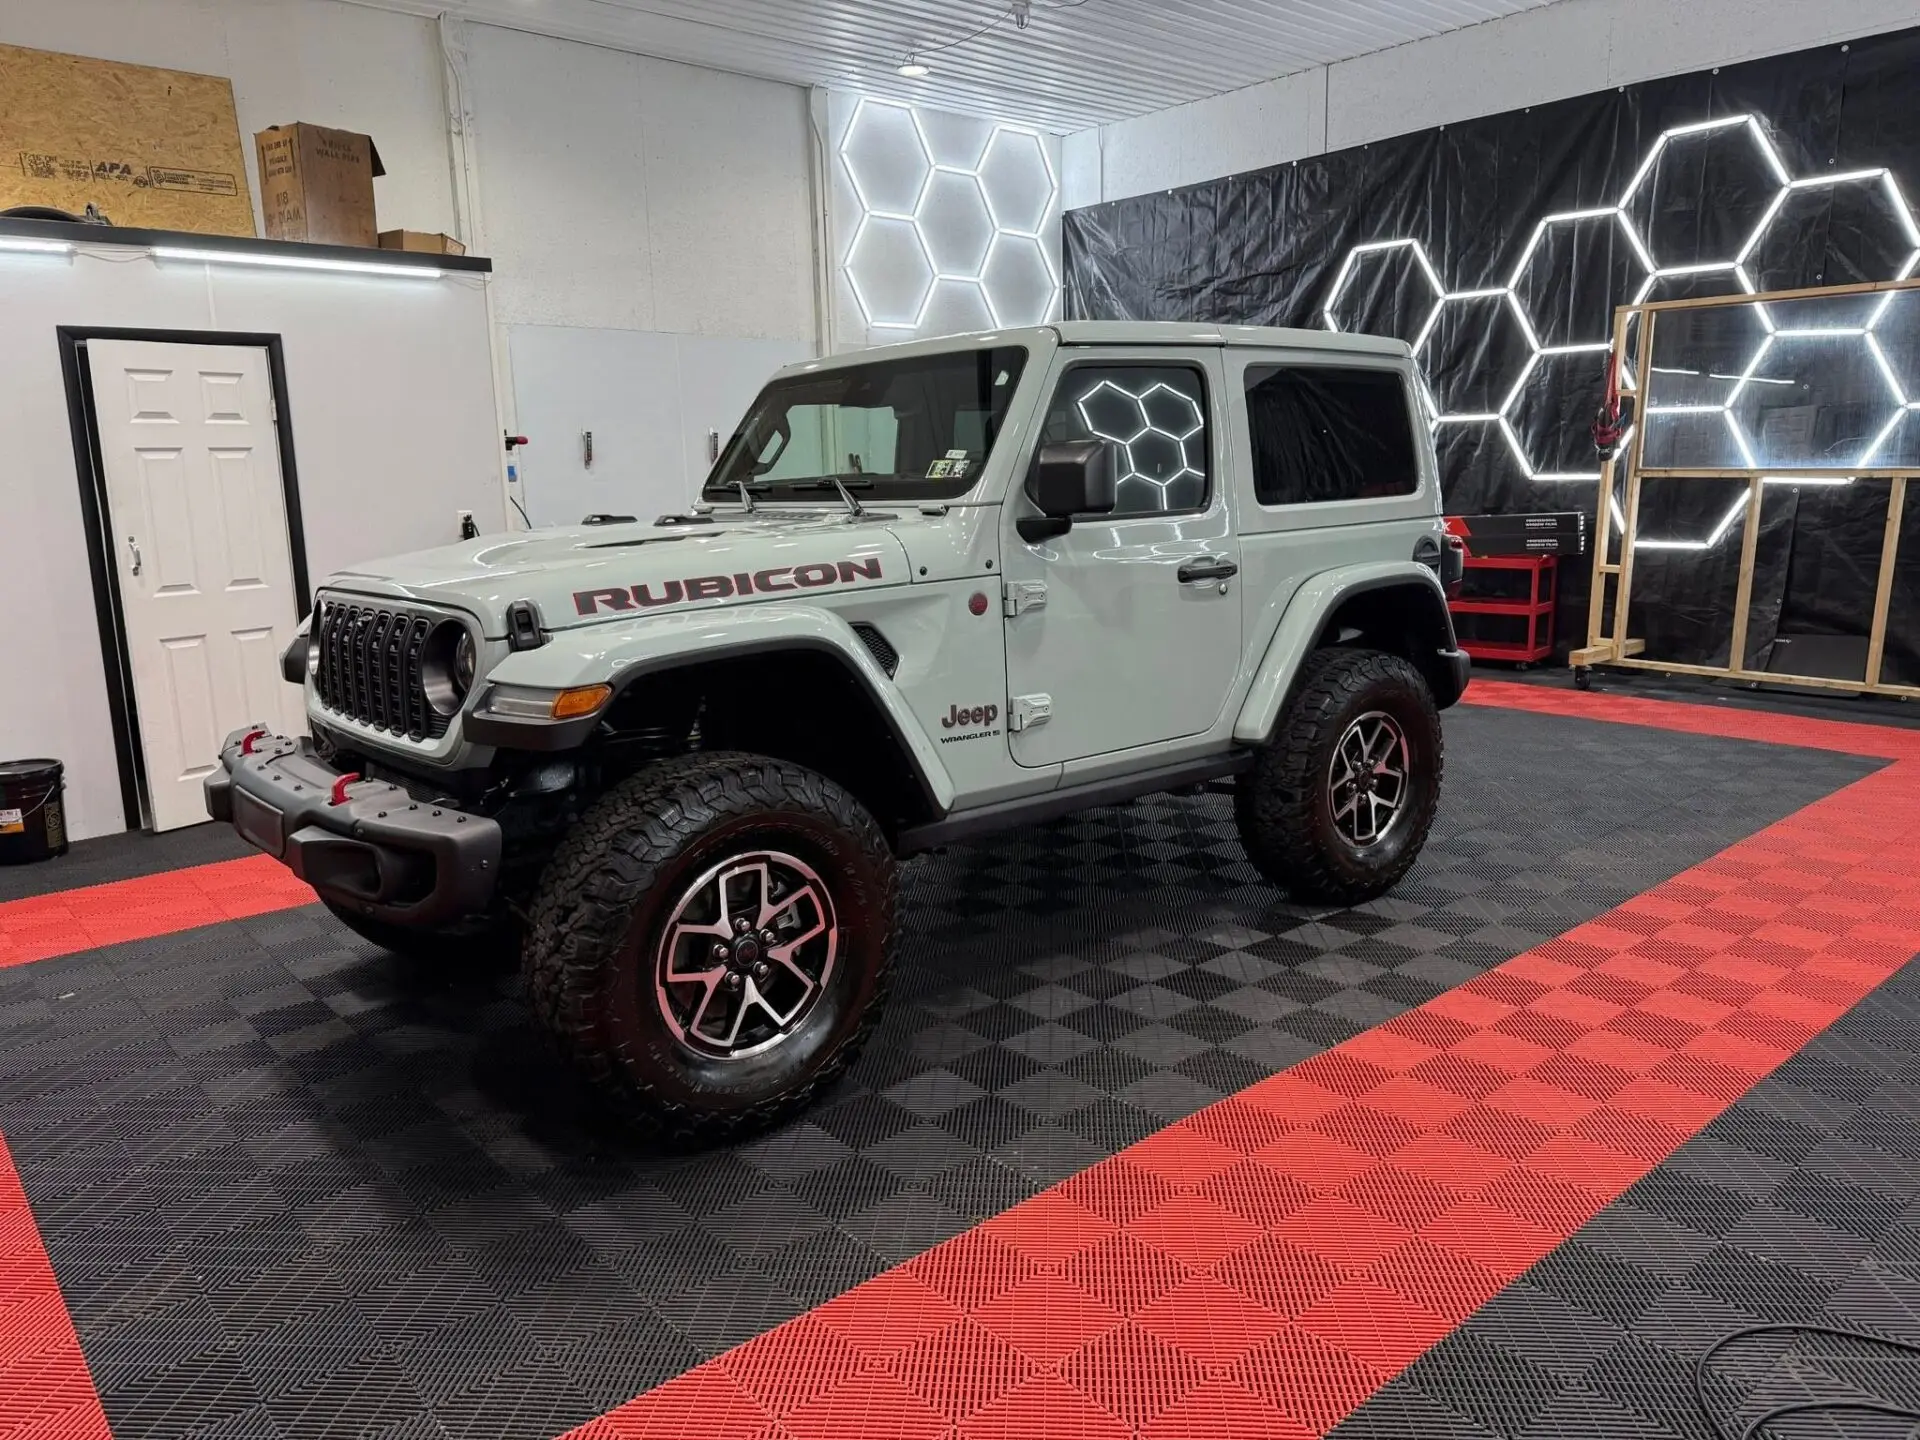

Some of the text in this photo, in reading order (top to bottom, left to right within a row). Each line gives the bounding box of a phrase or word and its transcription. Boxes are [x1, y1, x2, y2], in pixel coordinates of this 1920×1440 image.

[95, 161, 132, 176] APA
[572, 557, 883, 616] RUBICON
[941, 703, 999, 729] Jeep
[940, 730, 991, 744] WRANGLER
